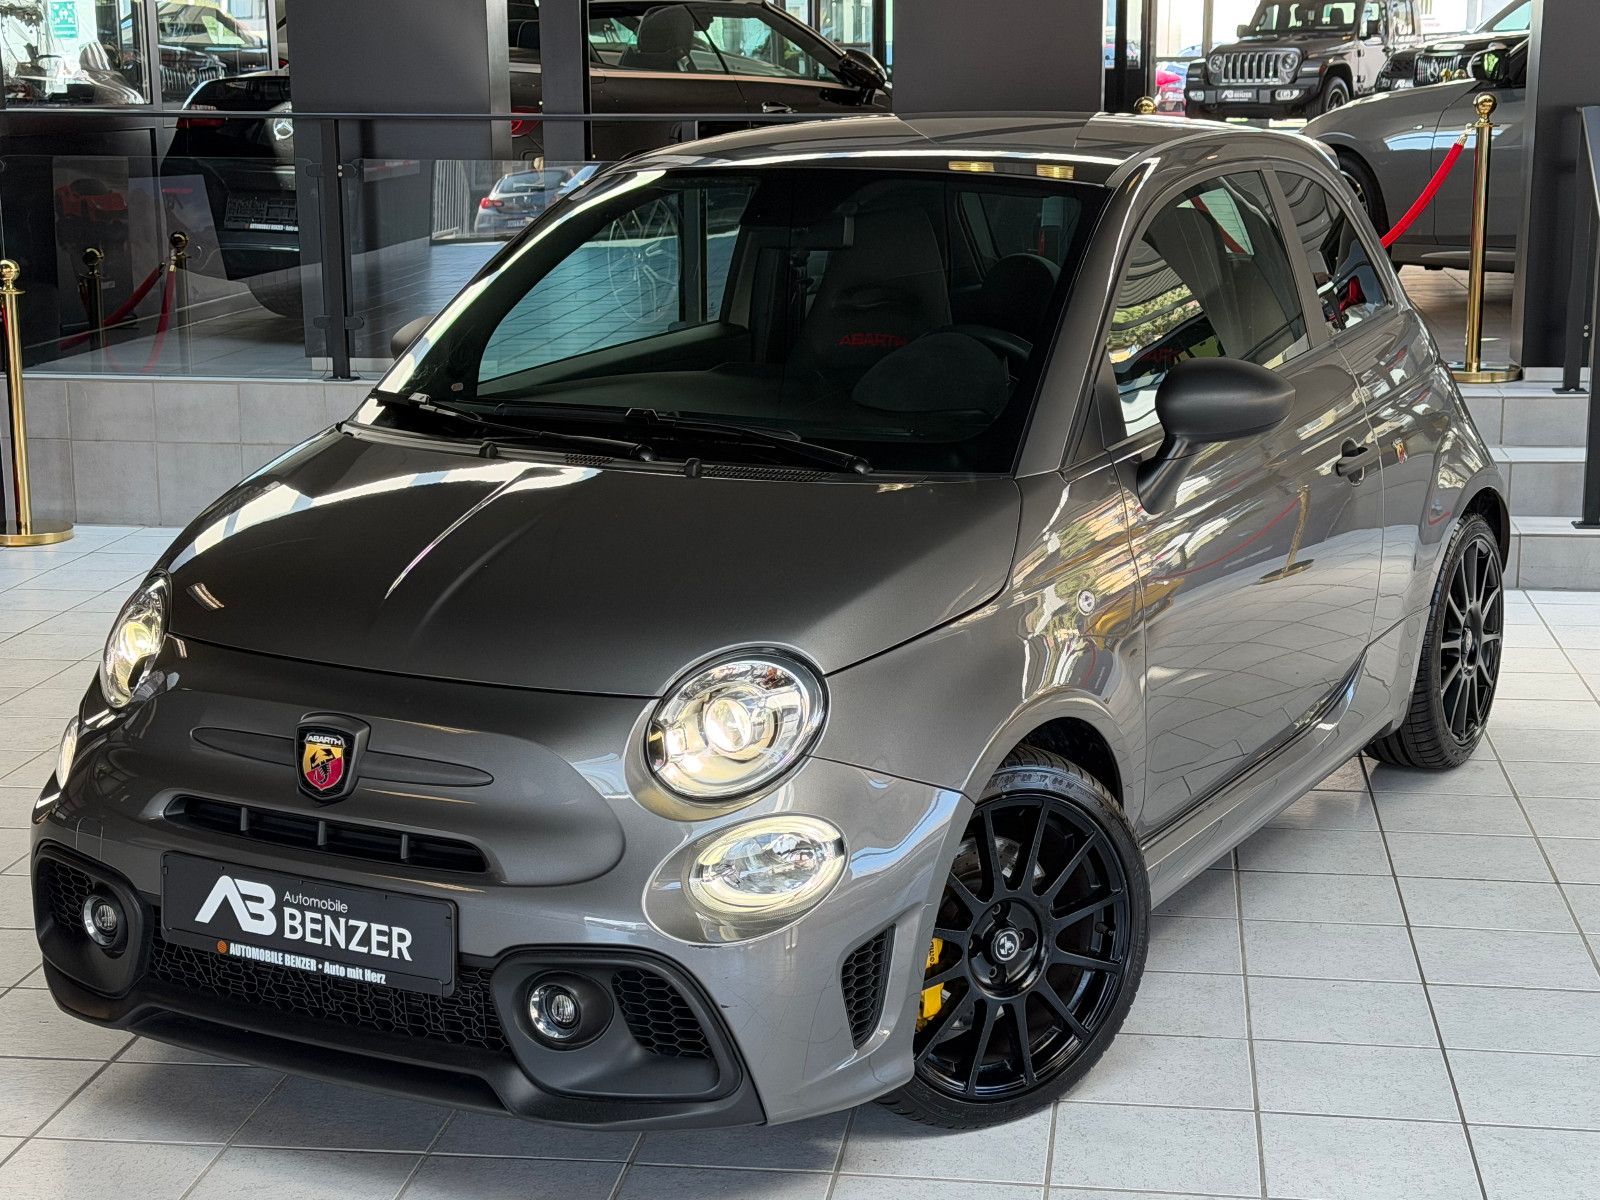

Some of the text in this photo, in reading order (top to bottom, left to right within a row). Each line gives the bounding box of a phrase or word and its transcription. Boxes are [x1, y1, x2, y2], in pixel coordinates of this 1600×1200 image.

[308, 736, 341, 745] ABARTH
[194, 875, 277, 936] AB
[283, 891, 348, 914] Automobile
[282, 906, 413, 962] BENZER
[229, 942, 387, 985] AUTOMOBILE BENZER Auto mit Herz
